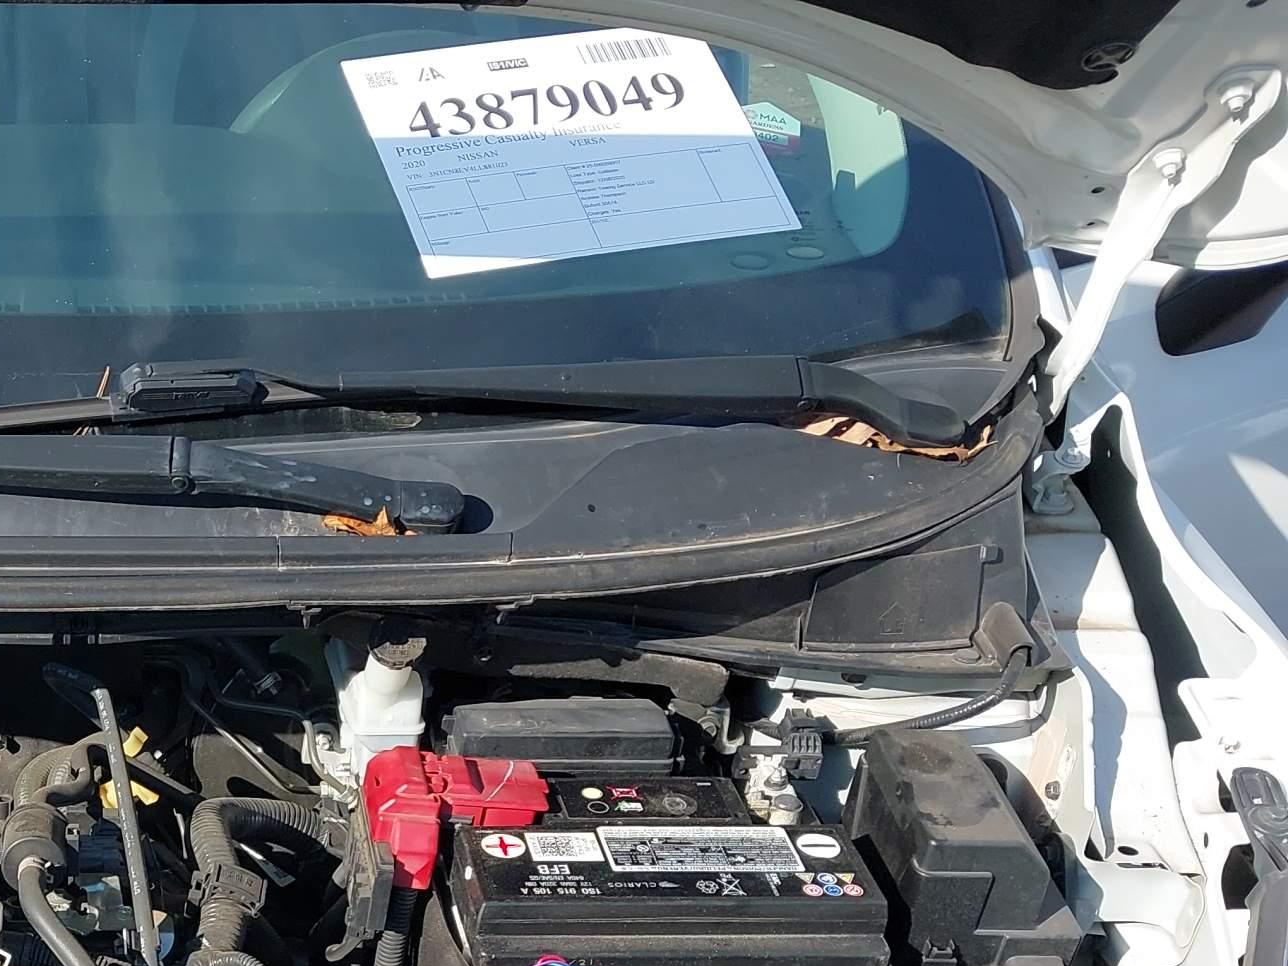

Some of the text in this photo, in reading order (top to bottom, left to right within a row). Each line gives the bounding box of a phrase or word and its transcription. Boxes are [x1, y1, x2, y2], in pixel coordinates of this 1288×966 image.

[408, 71, 686, 138] 43879049
[759, 112, 787, 125] MAA
[395, 122, 622, 157] Progressive Casualty Insurance
[401, 137, 607, 170] 2020 NISSAN VERSA
[537, 864, 571, 875] EFB
[532, 887, 553, 895] 105
[556, 887, 577, 895] 915
